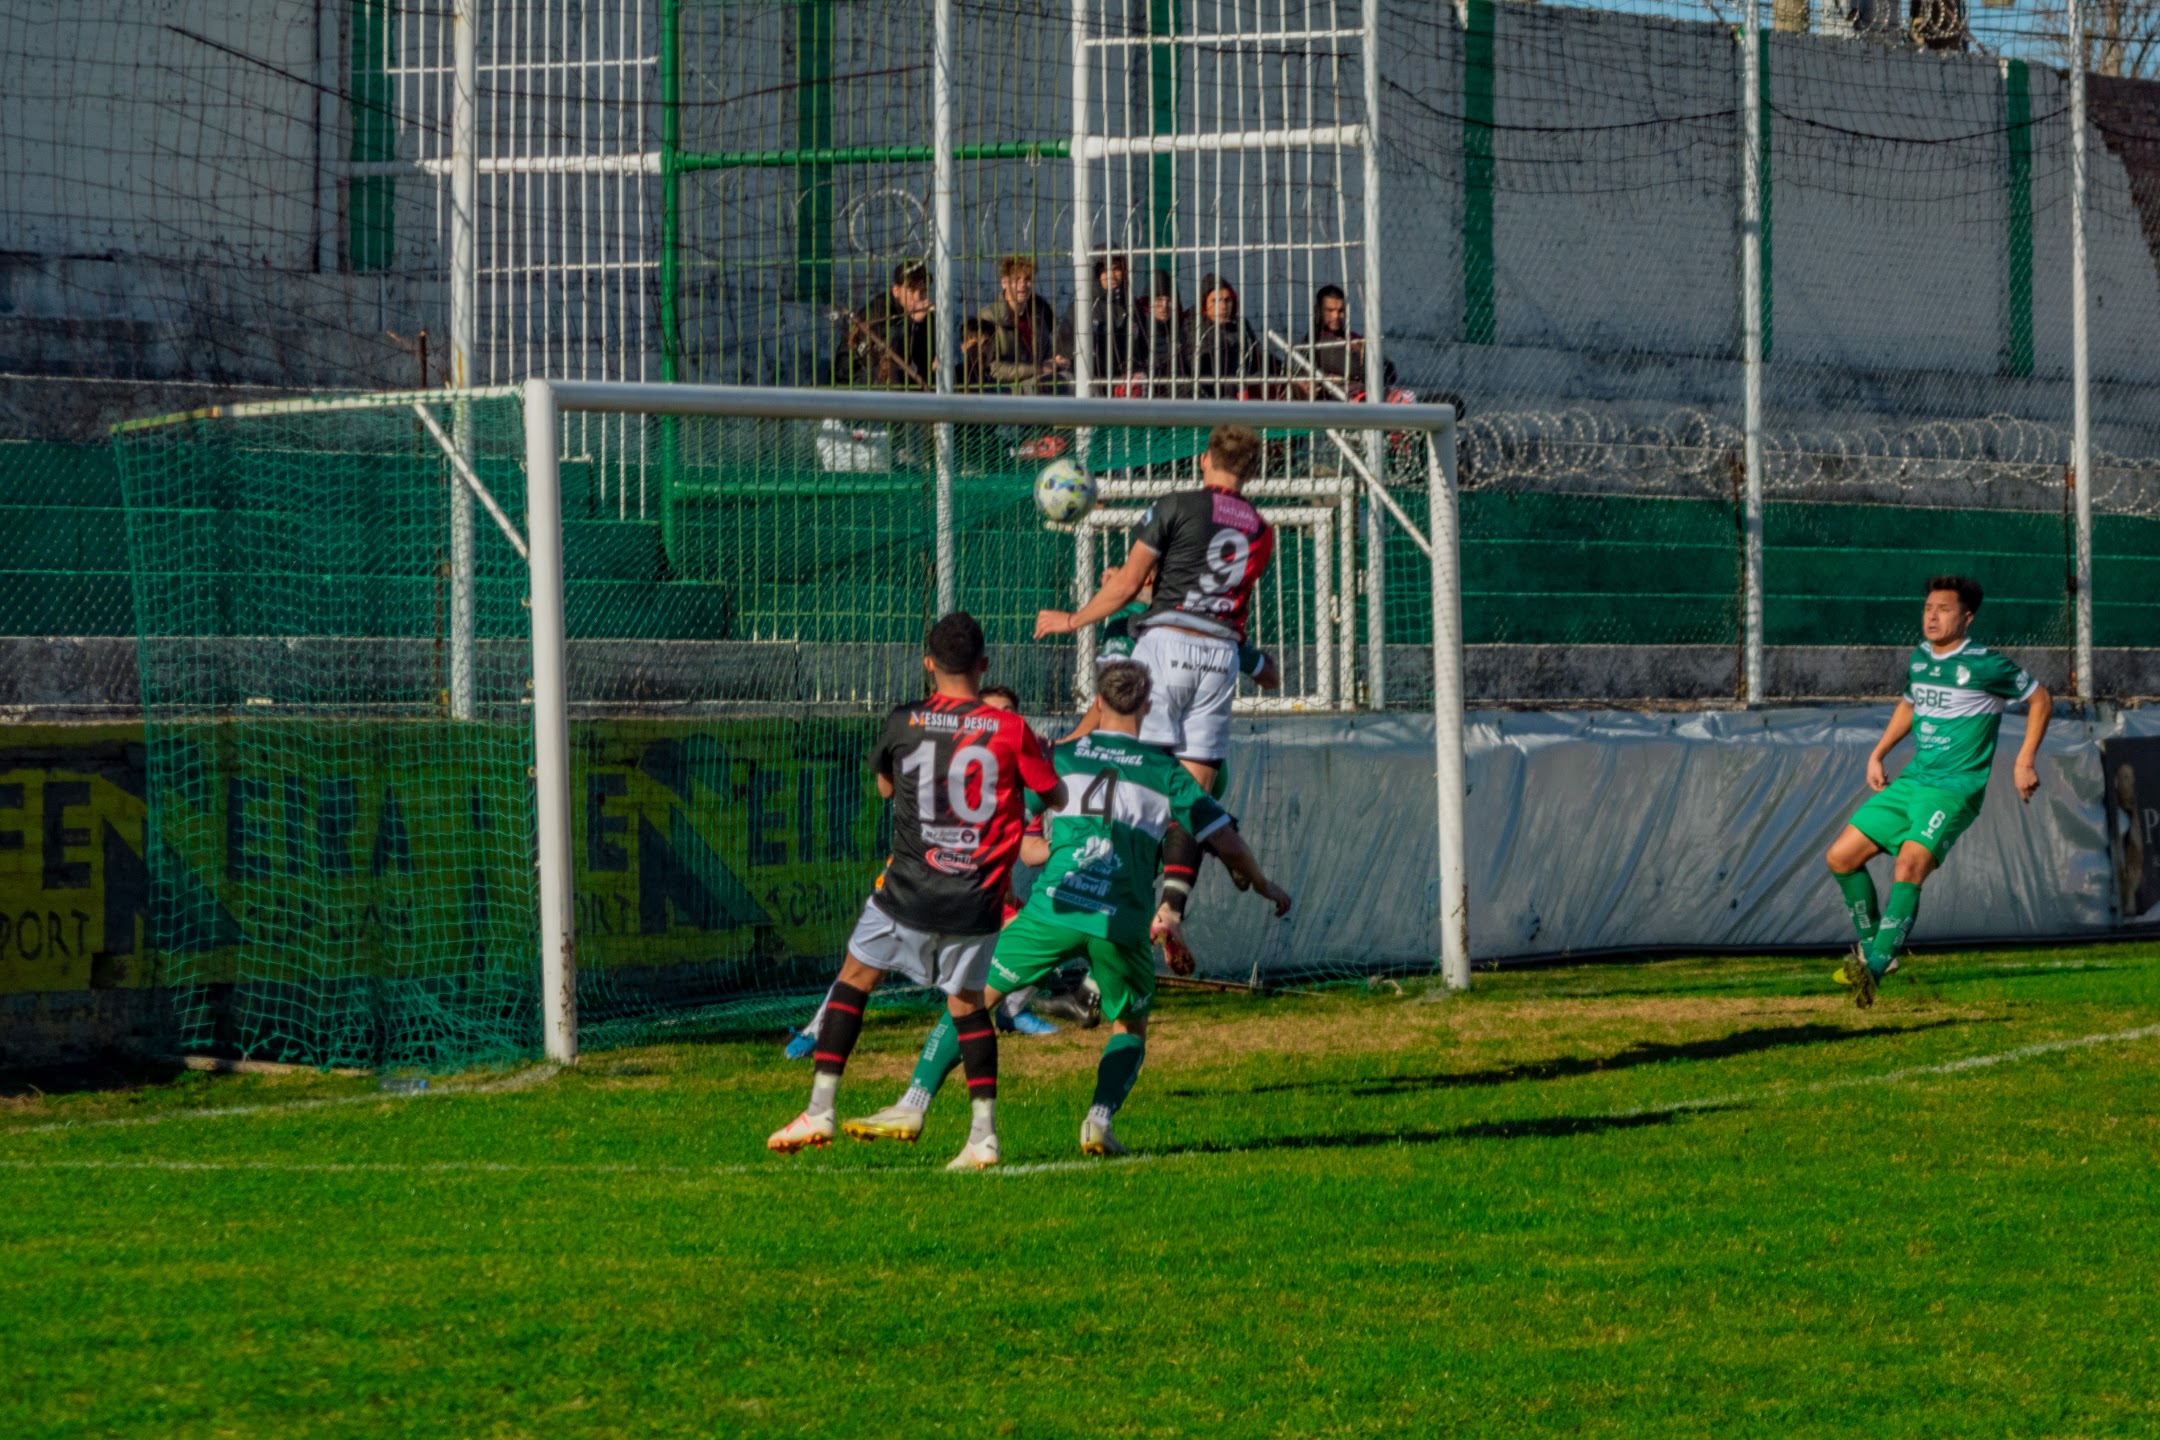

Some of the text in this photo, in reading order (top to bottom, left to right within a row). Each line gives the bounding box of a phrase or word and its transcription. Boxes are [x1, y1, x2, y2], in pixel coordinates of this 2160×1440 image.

[1198, 528, 1250, 594] 9
[909, 711, 959, 729] MESSINA
[963, 717, 999, 732] DESIGN
[1074, 747, 1099, 760] SAN
[902, 740, 999, 823] 10
[1081, 767, 1119, 825] 4
[1928, 810, 1946, 829] 6
